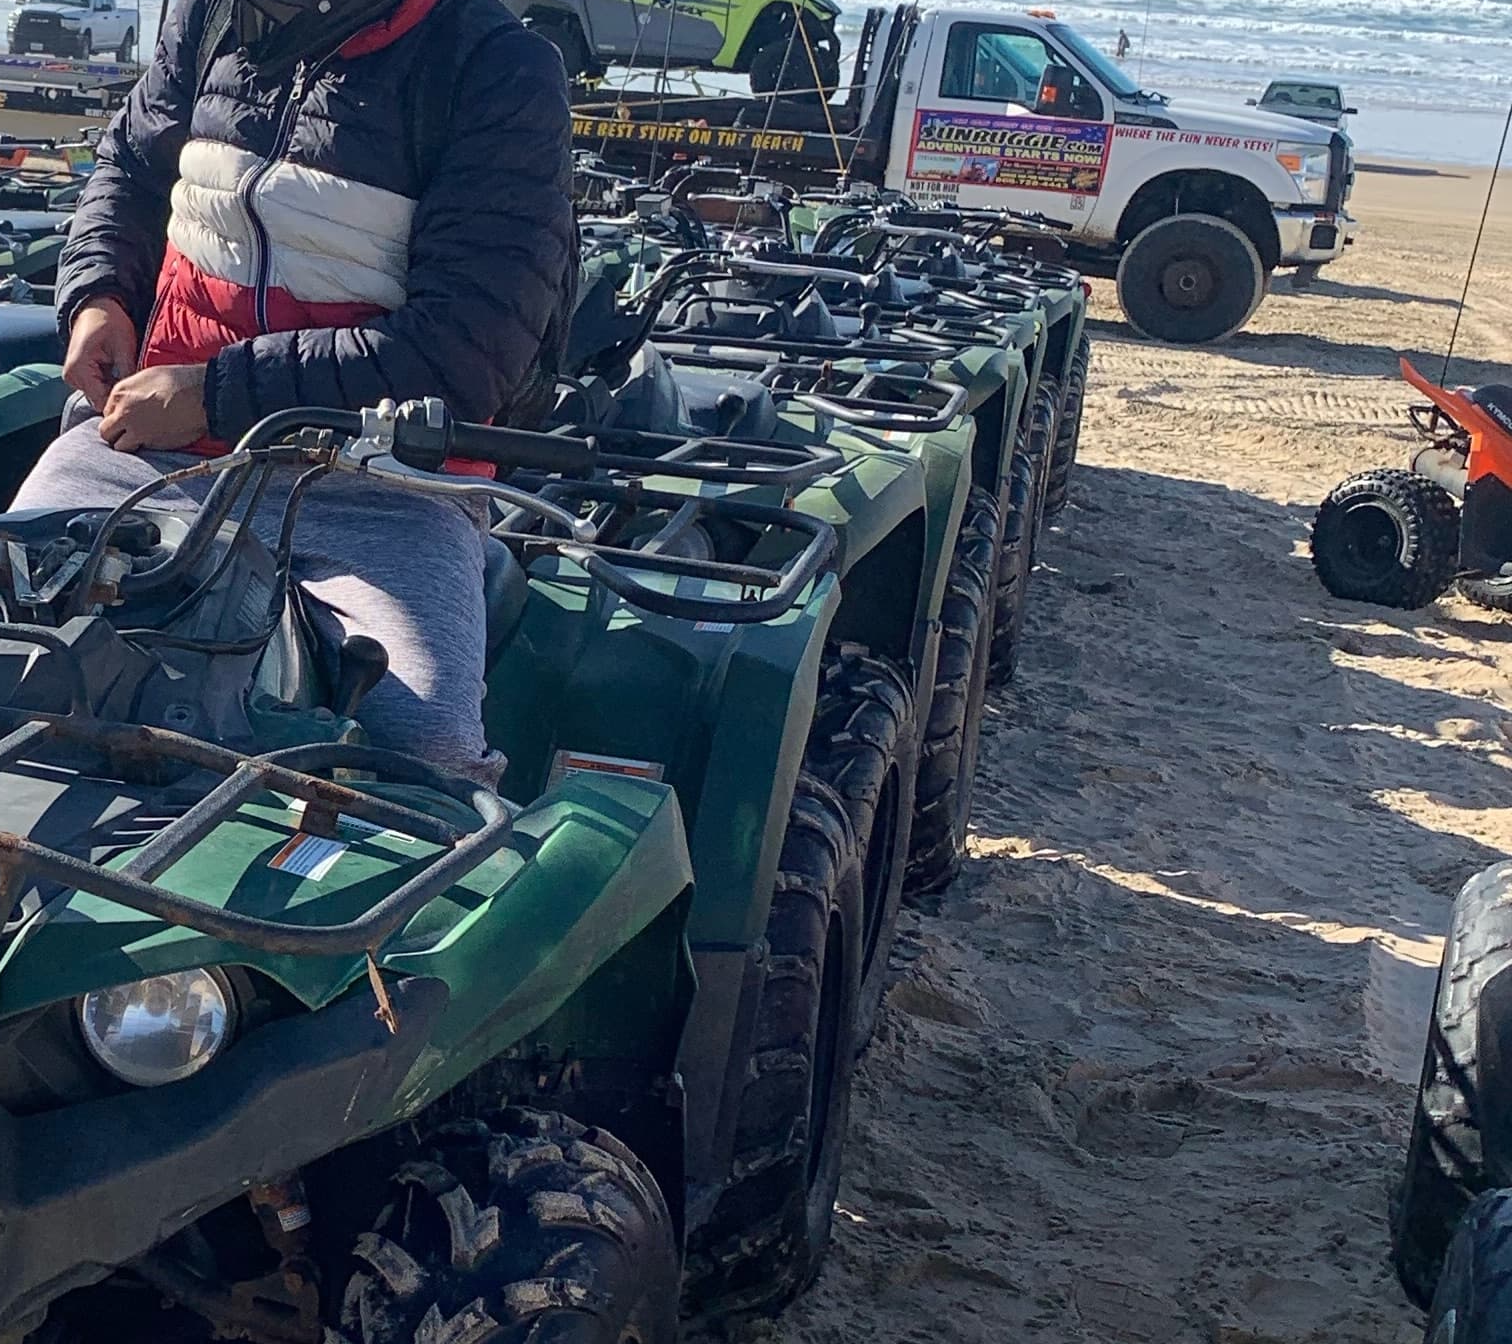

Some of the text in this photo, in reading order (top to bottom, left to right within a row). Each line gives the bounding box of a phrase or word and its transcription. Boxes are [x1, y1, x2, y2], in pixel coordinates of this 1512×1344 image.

[571, 120, 592, 136] HE
[597, 122, 635, 139] BEST
[638, 125, 686, 143] STUFF
[689, 128, 711, 145] ON
[1114, 127, 1275, 152] WHERE THE FUN NEVER SETS!
[917, 141, 1102, 165] ADVENTURE STARTS NOW!
